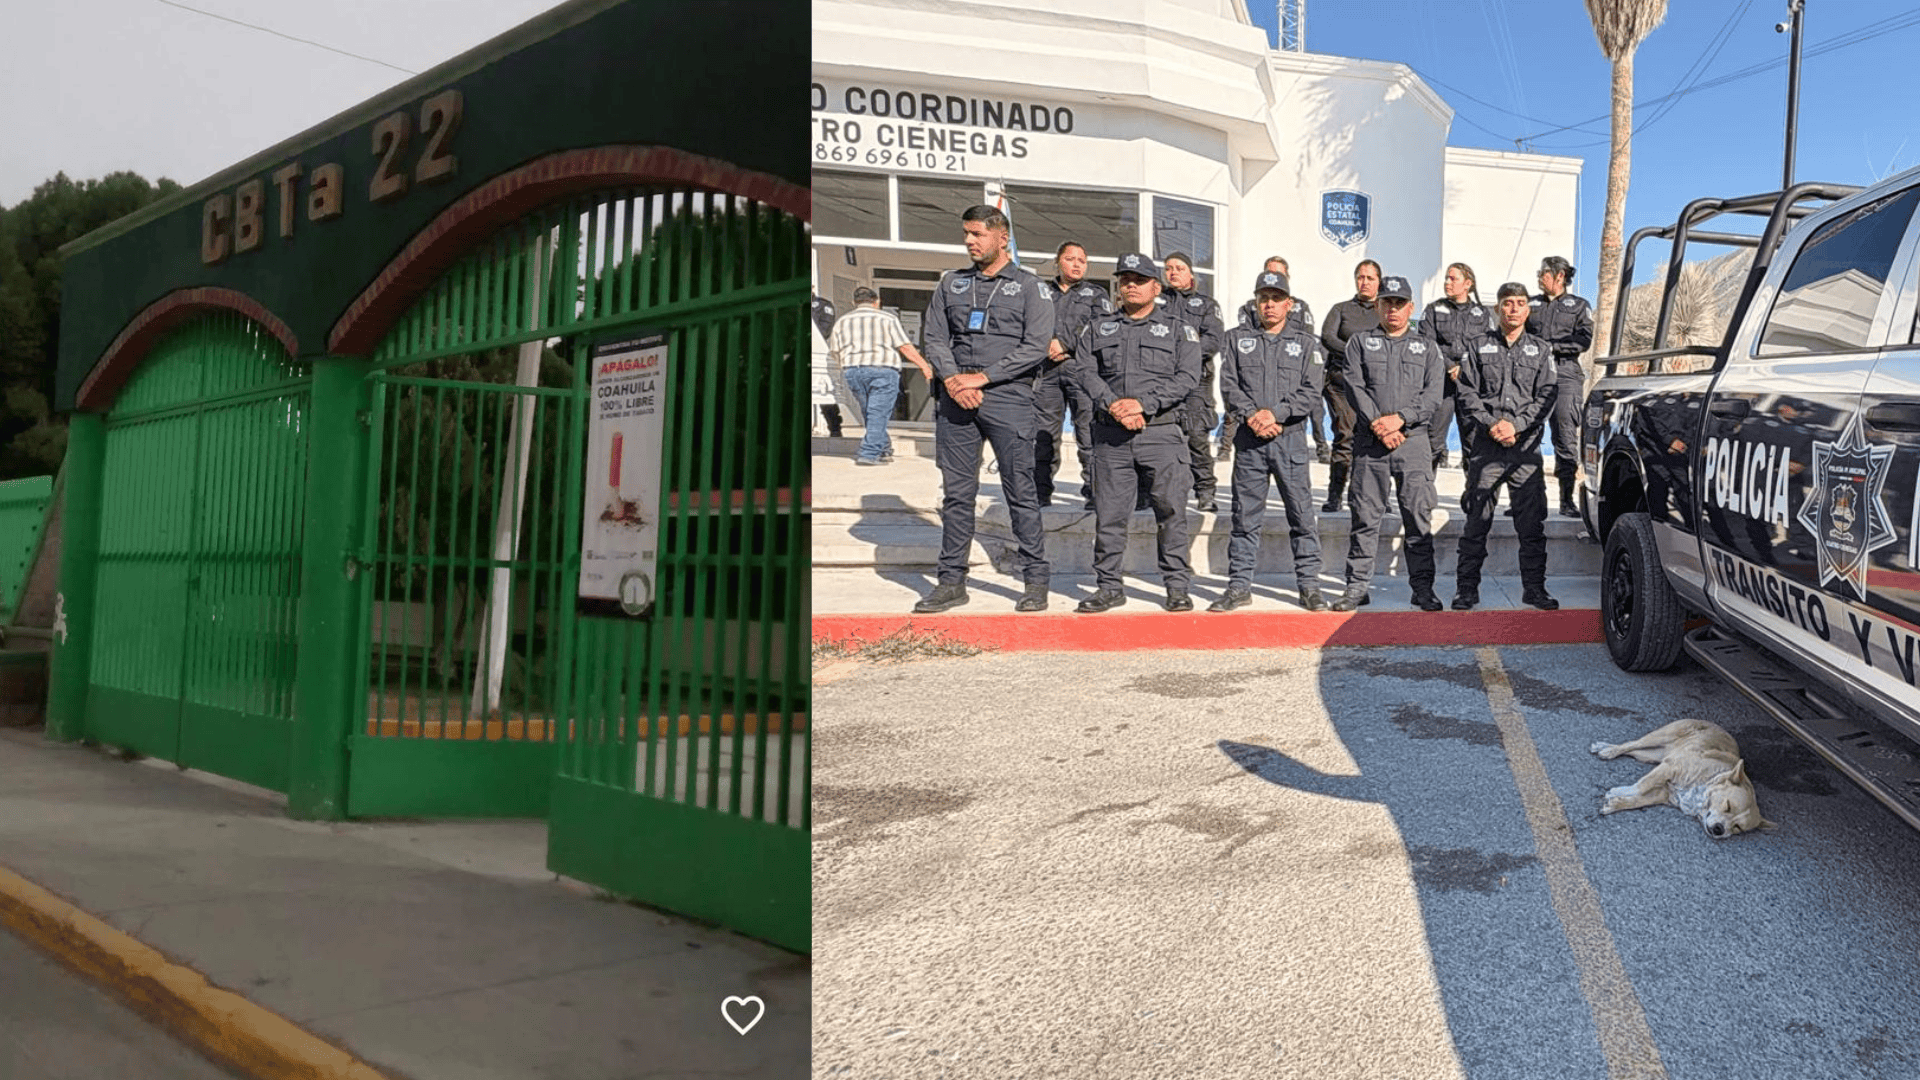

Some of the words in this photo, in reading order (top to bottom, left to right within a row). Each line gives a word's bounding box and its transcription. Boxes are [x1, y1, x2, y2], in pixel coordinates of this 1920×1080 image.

[845, 87, 1073, 134] COORDINADO
[815, 143, 857, 163] 869
[866, 148, 908, 168] 696
[917, 152, 936, 168] 10
[946, 156, 966, 171] 21
[877, 123, 1029, 158] CIÉNEGAS
[202, 161, 343, 264] CBTa
[369, 89, 463, 202] 22
[598, 380, 655, 398] COAHUILA
[601, 400, 622, 411] 100%
[626, 396, 654, 408] LIBRE
[1711, 548, 1831, 642] TRANSITO
[1848, 610, 1873, 667] Y
